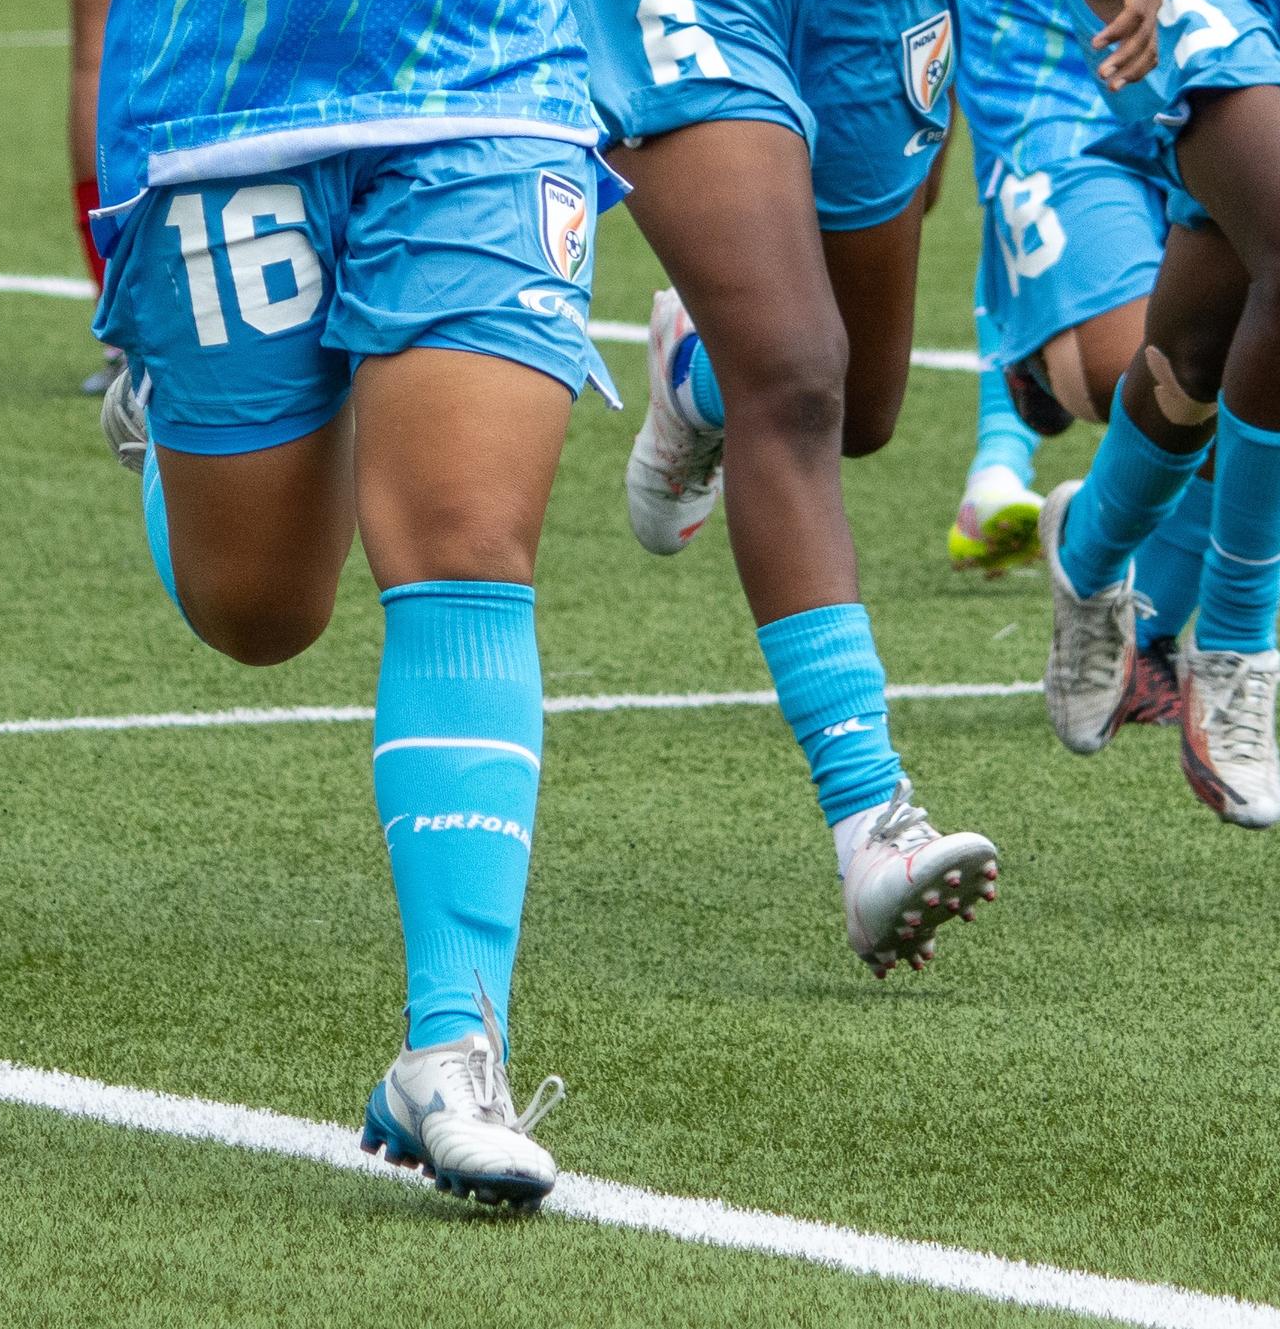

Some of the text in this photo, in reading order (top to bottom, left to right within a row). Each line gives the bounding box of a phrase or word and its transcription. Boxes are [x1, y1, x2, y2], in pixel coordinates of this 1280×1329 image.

[913, 31, 937, 50] INDIA
[548, 188, 576, 210] INDIA
[165, 185, 323, 346] 16
